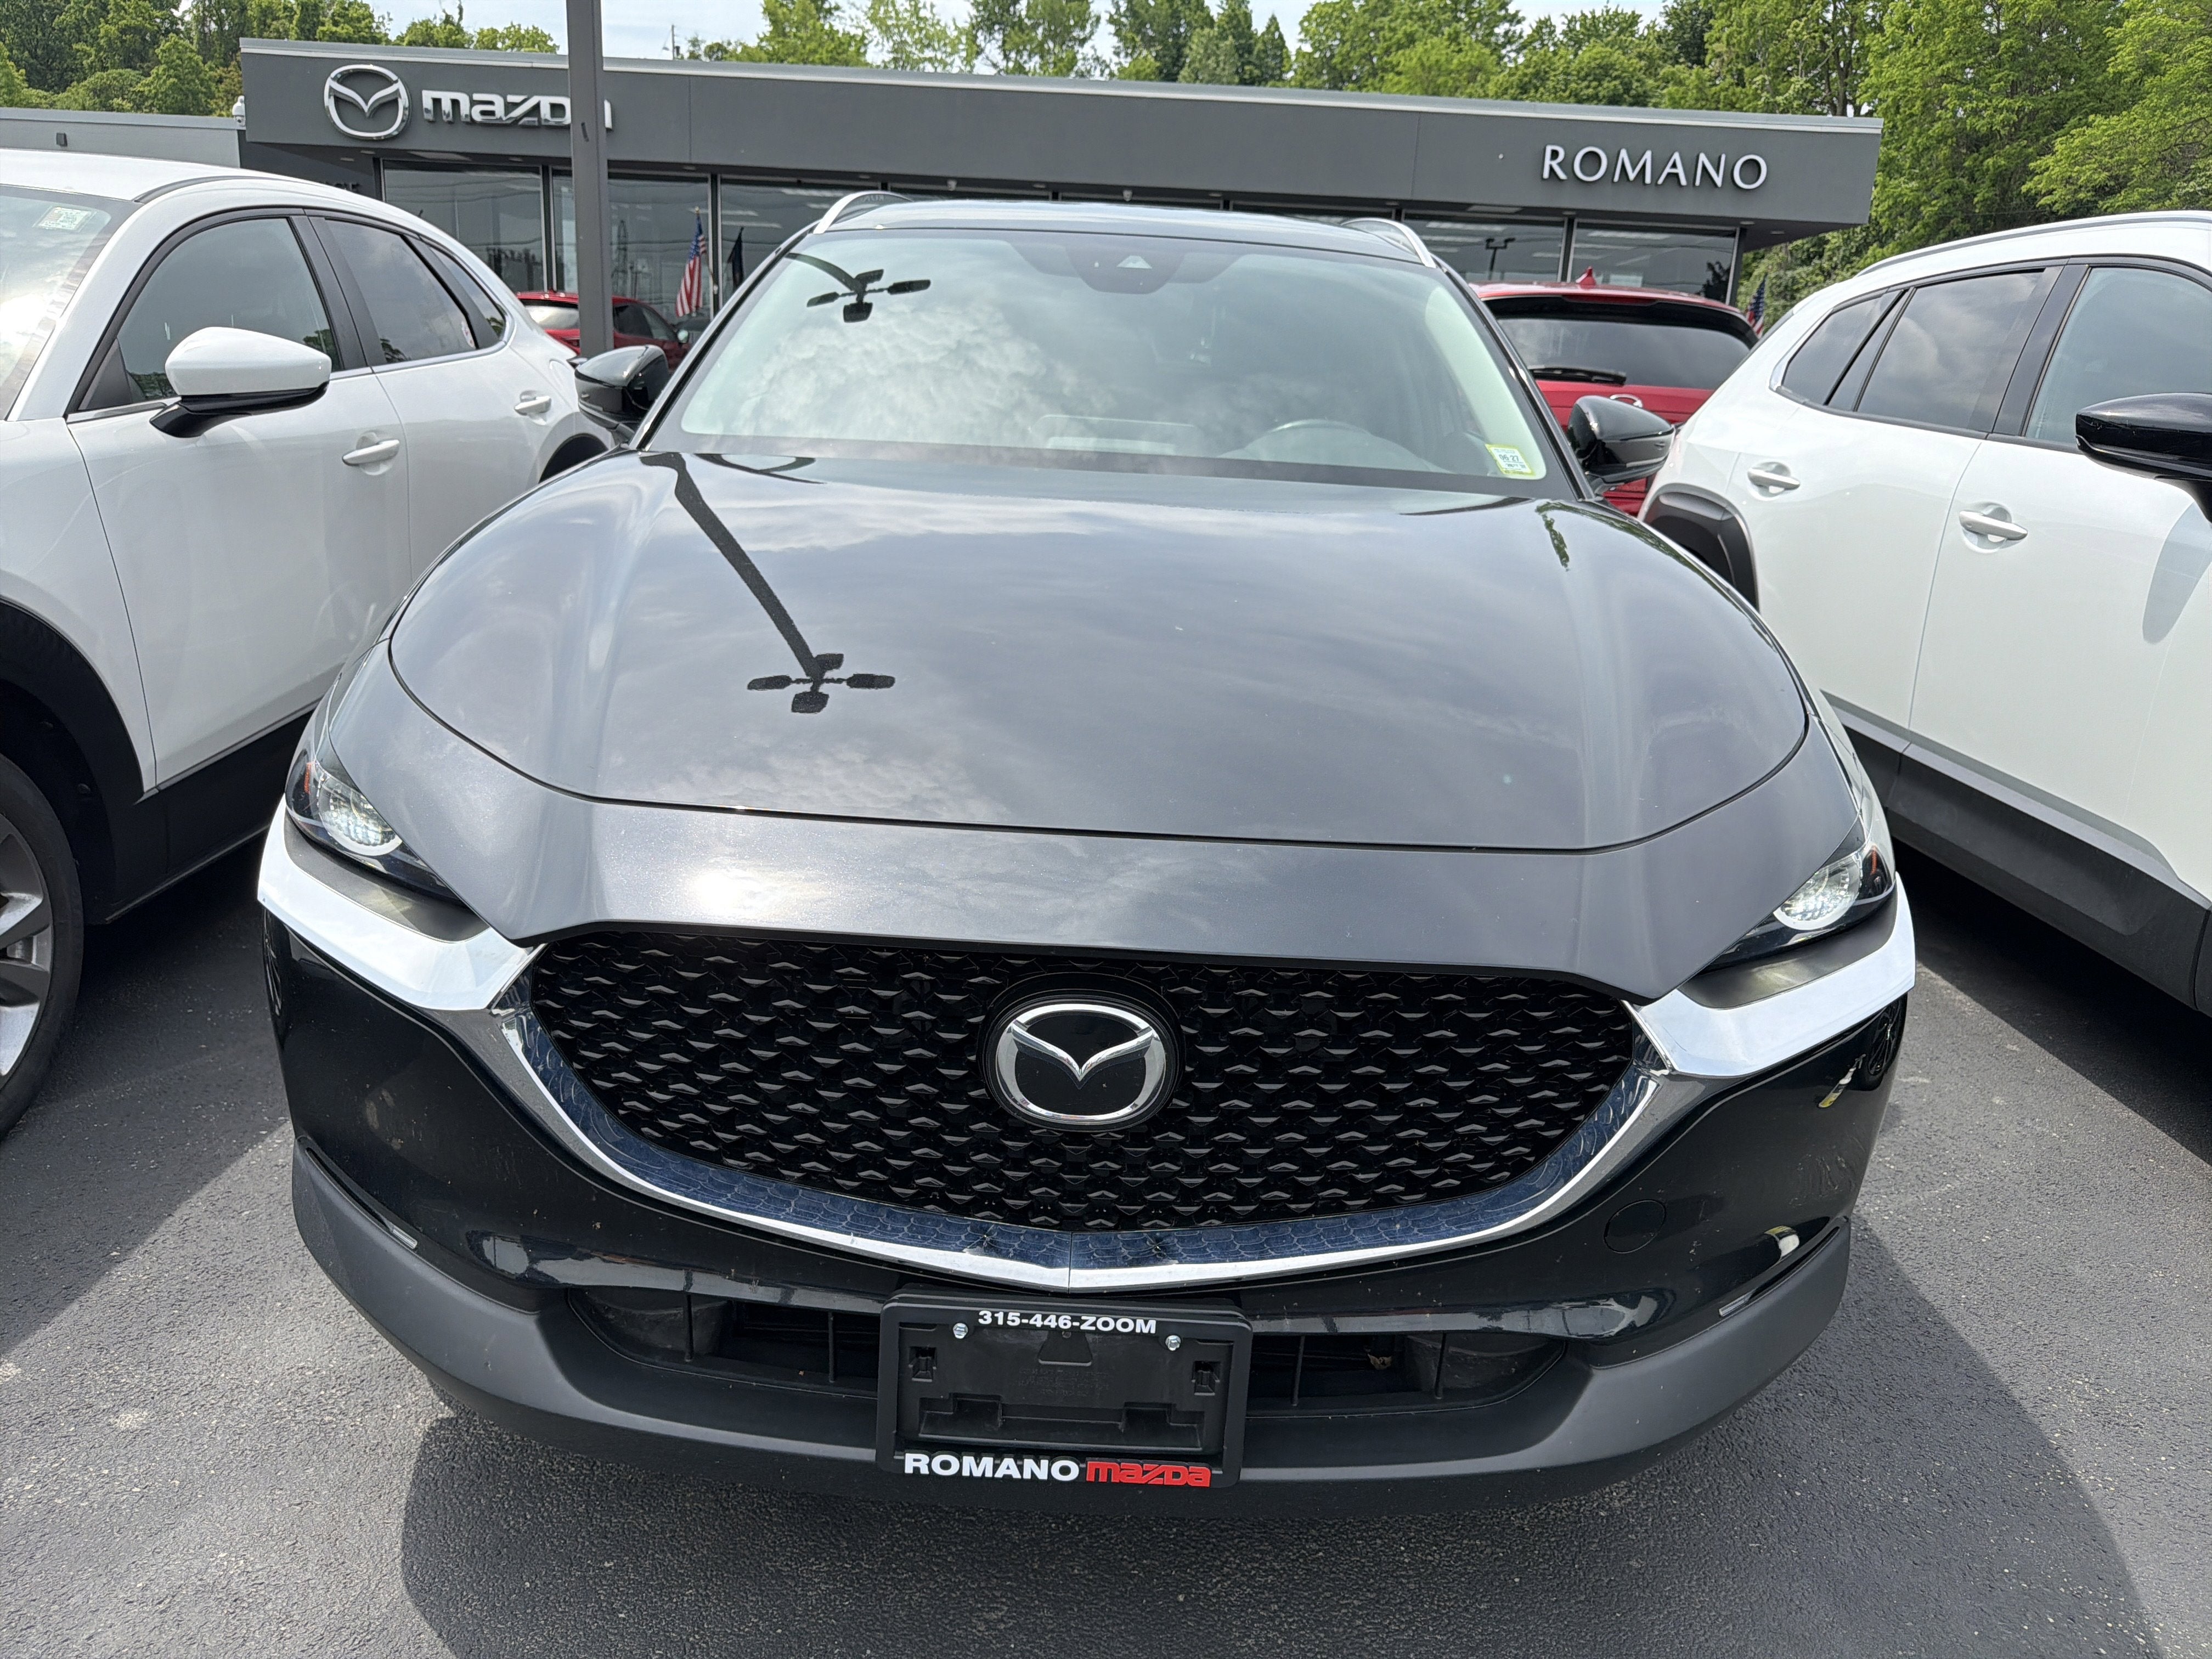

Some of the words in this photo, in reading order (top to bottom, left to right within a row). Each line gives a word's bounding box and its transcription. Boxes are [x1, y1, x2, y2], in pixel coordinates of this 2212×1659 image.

[422, 89, 612, 129] mazd
[1542, 144, 1768, 189] ROMANO
[978, 1310, 1156, 1334] 315-446-ZOOM
[904, 1453, 1080, 1481] ROMANO
